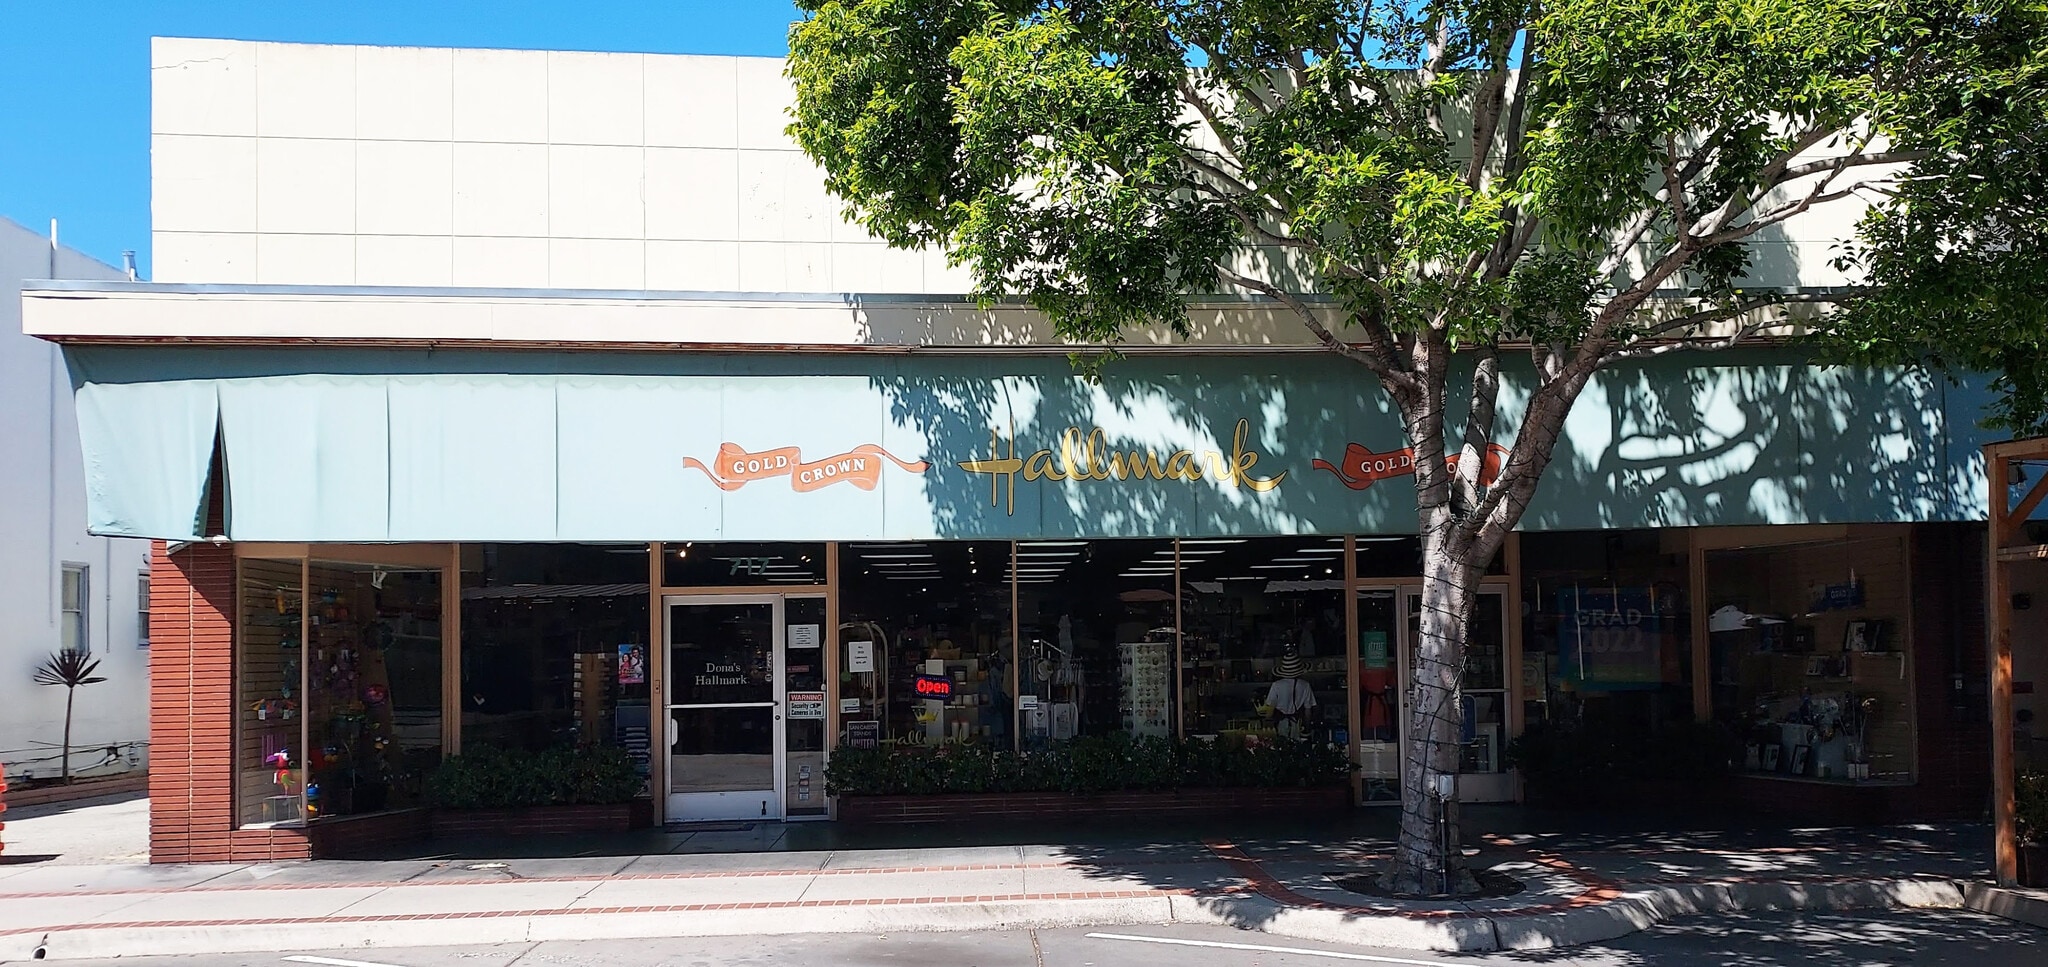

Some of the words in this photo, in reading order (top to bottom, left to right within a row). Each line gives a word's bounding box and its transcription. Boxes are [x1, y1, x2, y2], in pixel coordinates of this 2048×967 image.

[733, 455, 788, 474] GOLD
[799, 458, 866, 484] CROWN
[957, 415, 1288, 517] Hallmark
[1360, 455, 1411, 473] GOLD
[729, 557, 769, 576] 717
[1574, 608, 1642, 626] GRAD
[1574, 626, 1644, 653] 2022
[705, 662, 742, 673] Dona's
[695, 674, 748, 686] Hallmark
[917, 679, 949, 694] Open
[791, 702, 809, 710] Security
